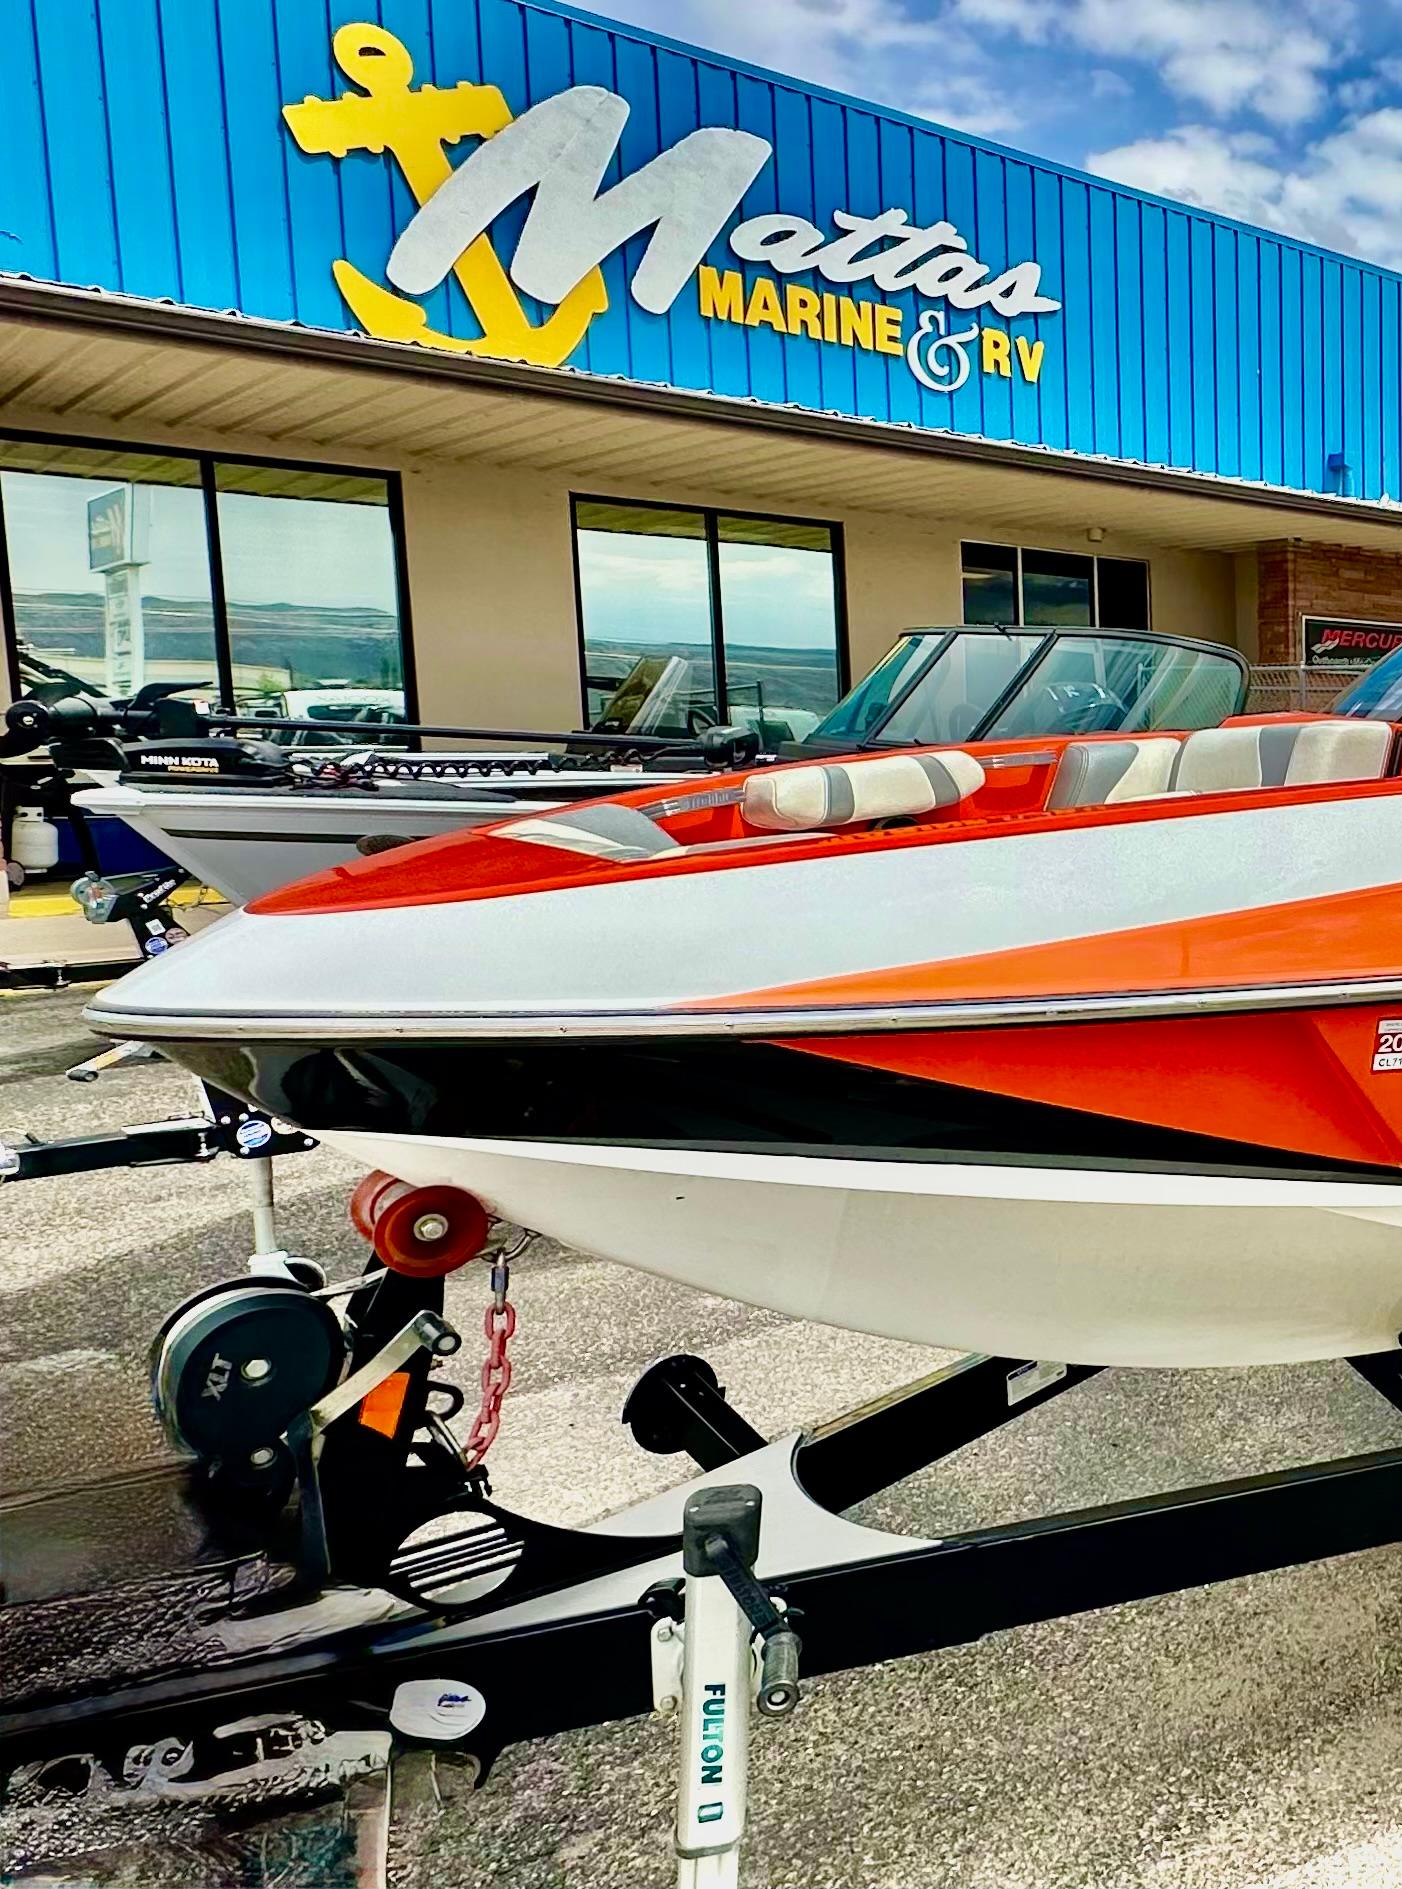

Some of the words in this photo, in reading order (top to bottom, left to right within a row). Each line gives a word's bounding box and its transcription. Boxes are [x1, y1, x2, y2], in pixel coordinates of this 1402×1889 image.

[386, 85, 1062, 314] Mattas
[698, 264, 903, 357] MARINE
[906, 308, 980, 394] &
[981, 328, 1045, 384] RV
[140, 755, 180, 766] MINN
[181, 757, 219, 768] KOTA
[201, 1352, 233, 1402] XLT
[700, 1683, 726, 1785] FULTON
